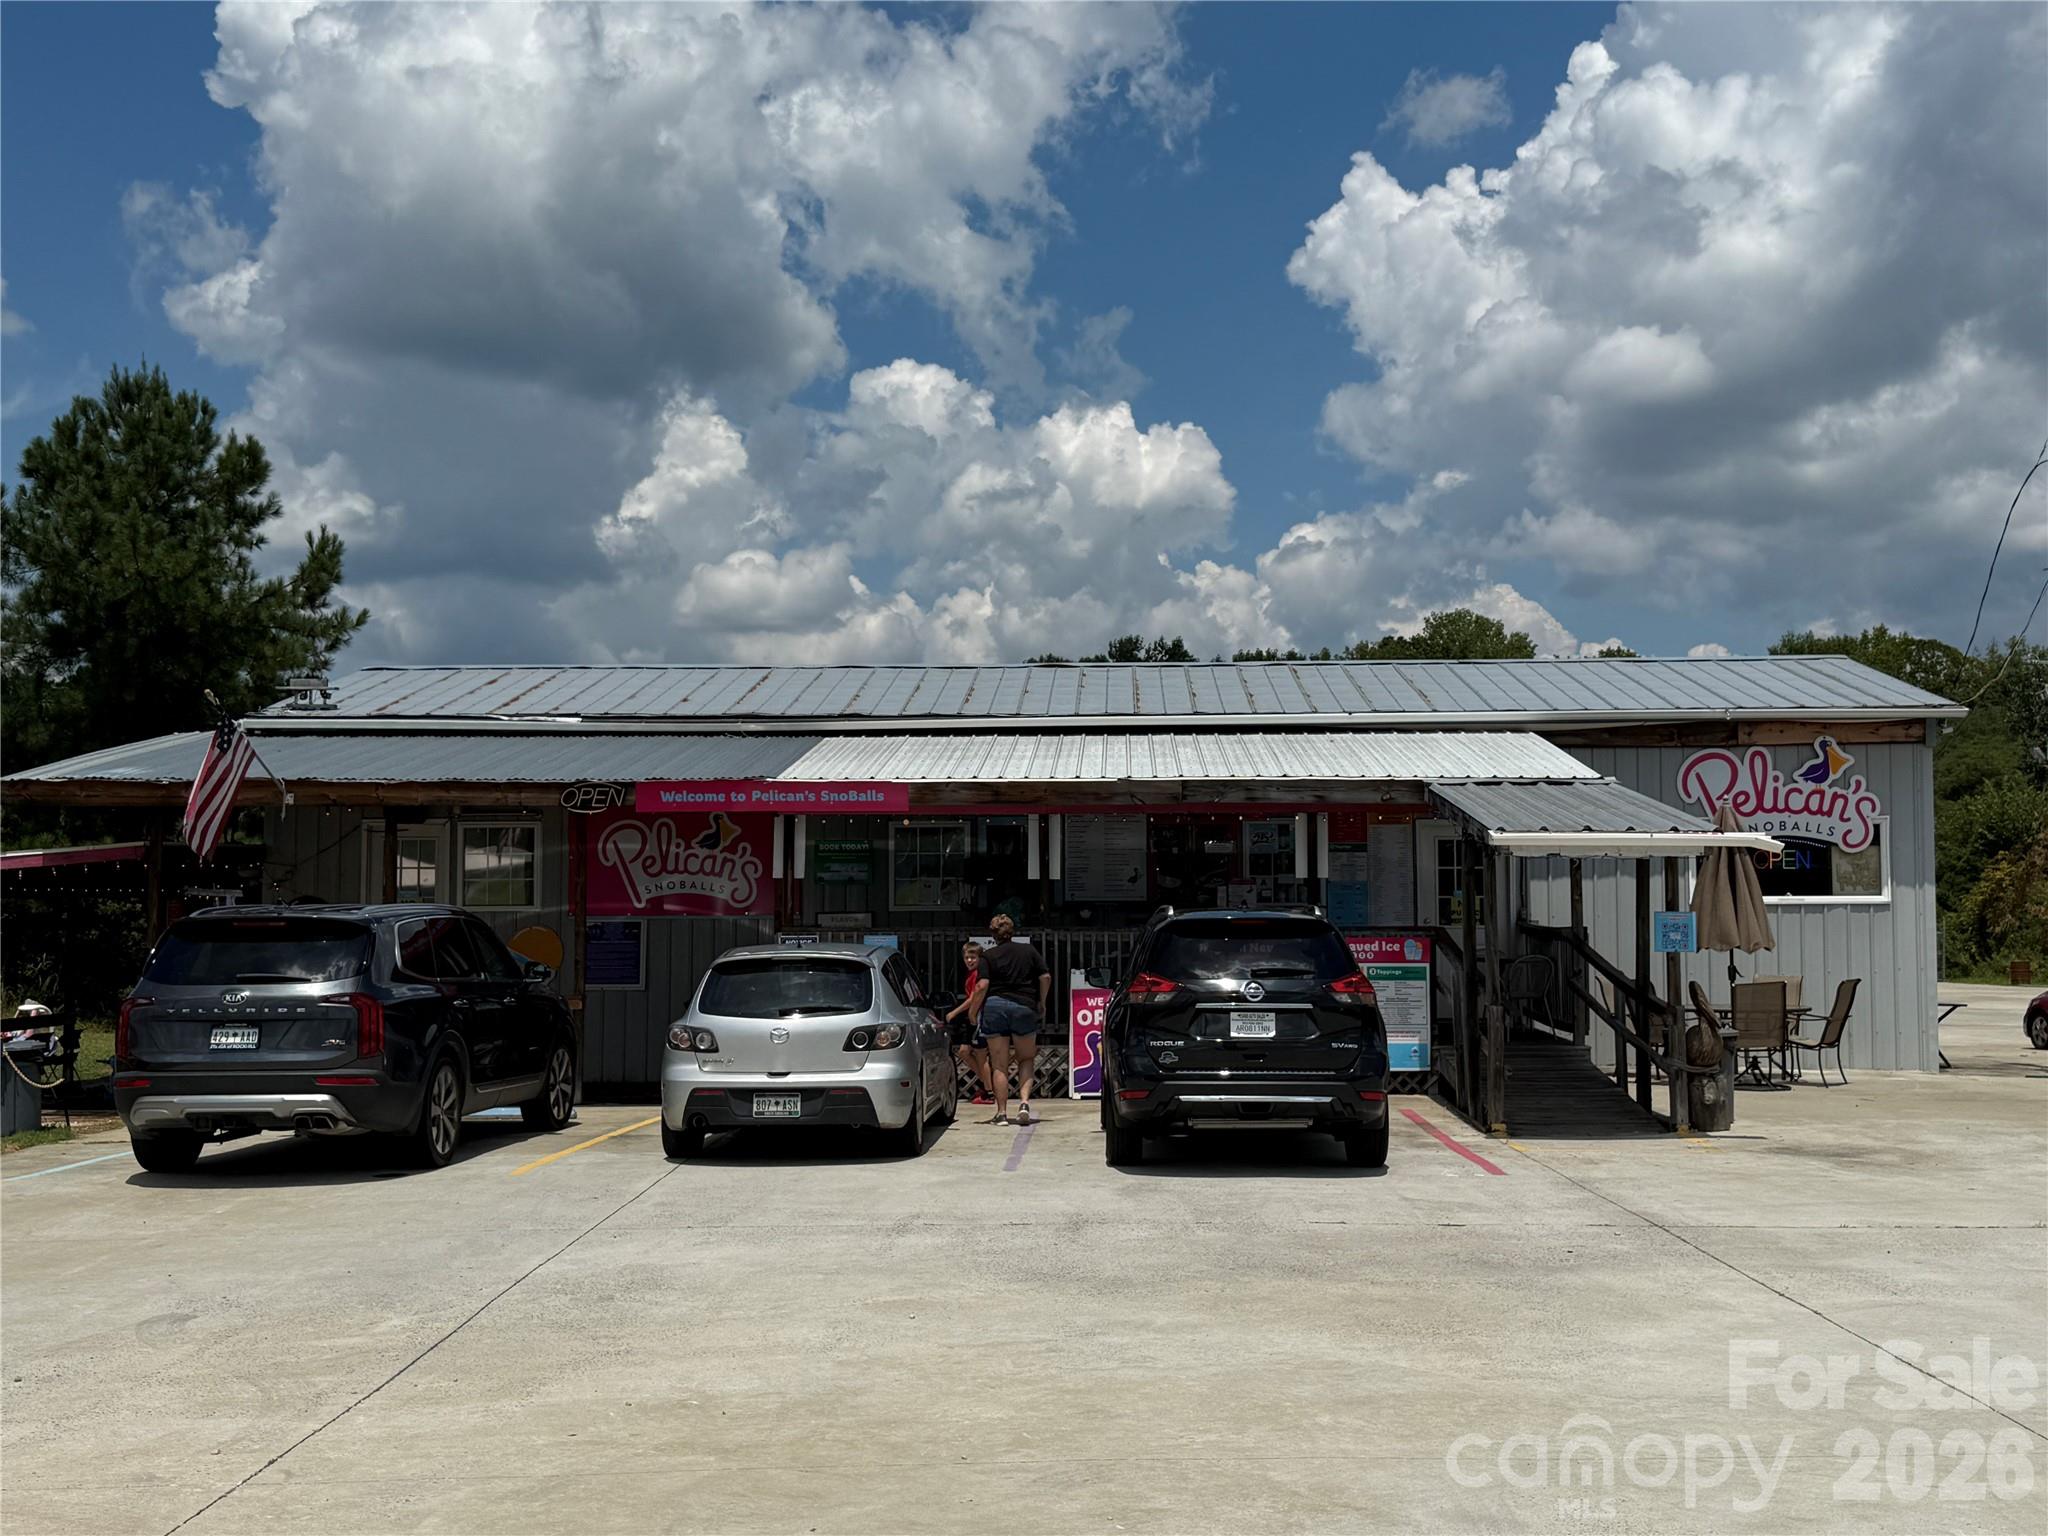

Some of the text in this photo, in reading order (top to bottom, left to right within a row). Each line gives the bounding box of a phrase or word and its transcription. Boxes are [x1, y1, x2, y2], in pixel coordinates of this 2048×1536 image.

[560, 787, 626, 807] OPEN
[660, 790, 885, 803] Welcome to Pelican's SnoBalls
[1681, 750, 1876, 849] Pelican's
[1748, 820, 1836, 837] NOBALLS
[601, 820, 759, 906] Pelican's
[1753, 849, 1812, 870] OPEN
[645, 880, 725, 895] SNOBALLS
[1382, 941, 1401, 952] Ice
[226, 994, 242, 1002] KIA
[1077, 1009, 1104, 1026] OP
[212, 1031, 230, 1042] 429
[756, 1099, 799, 1111] 807 ASN
